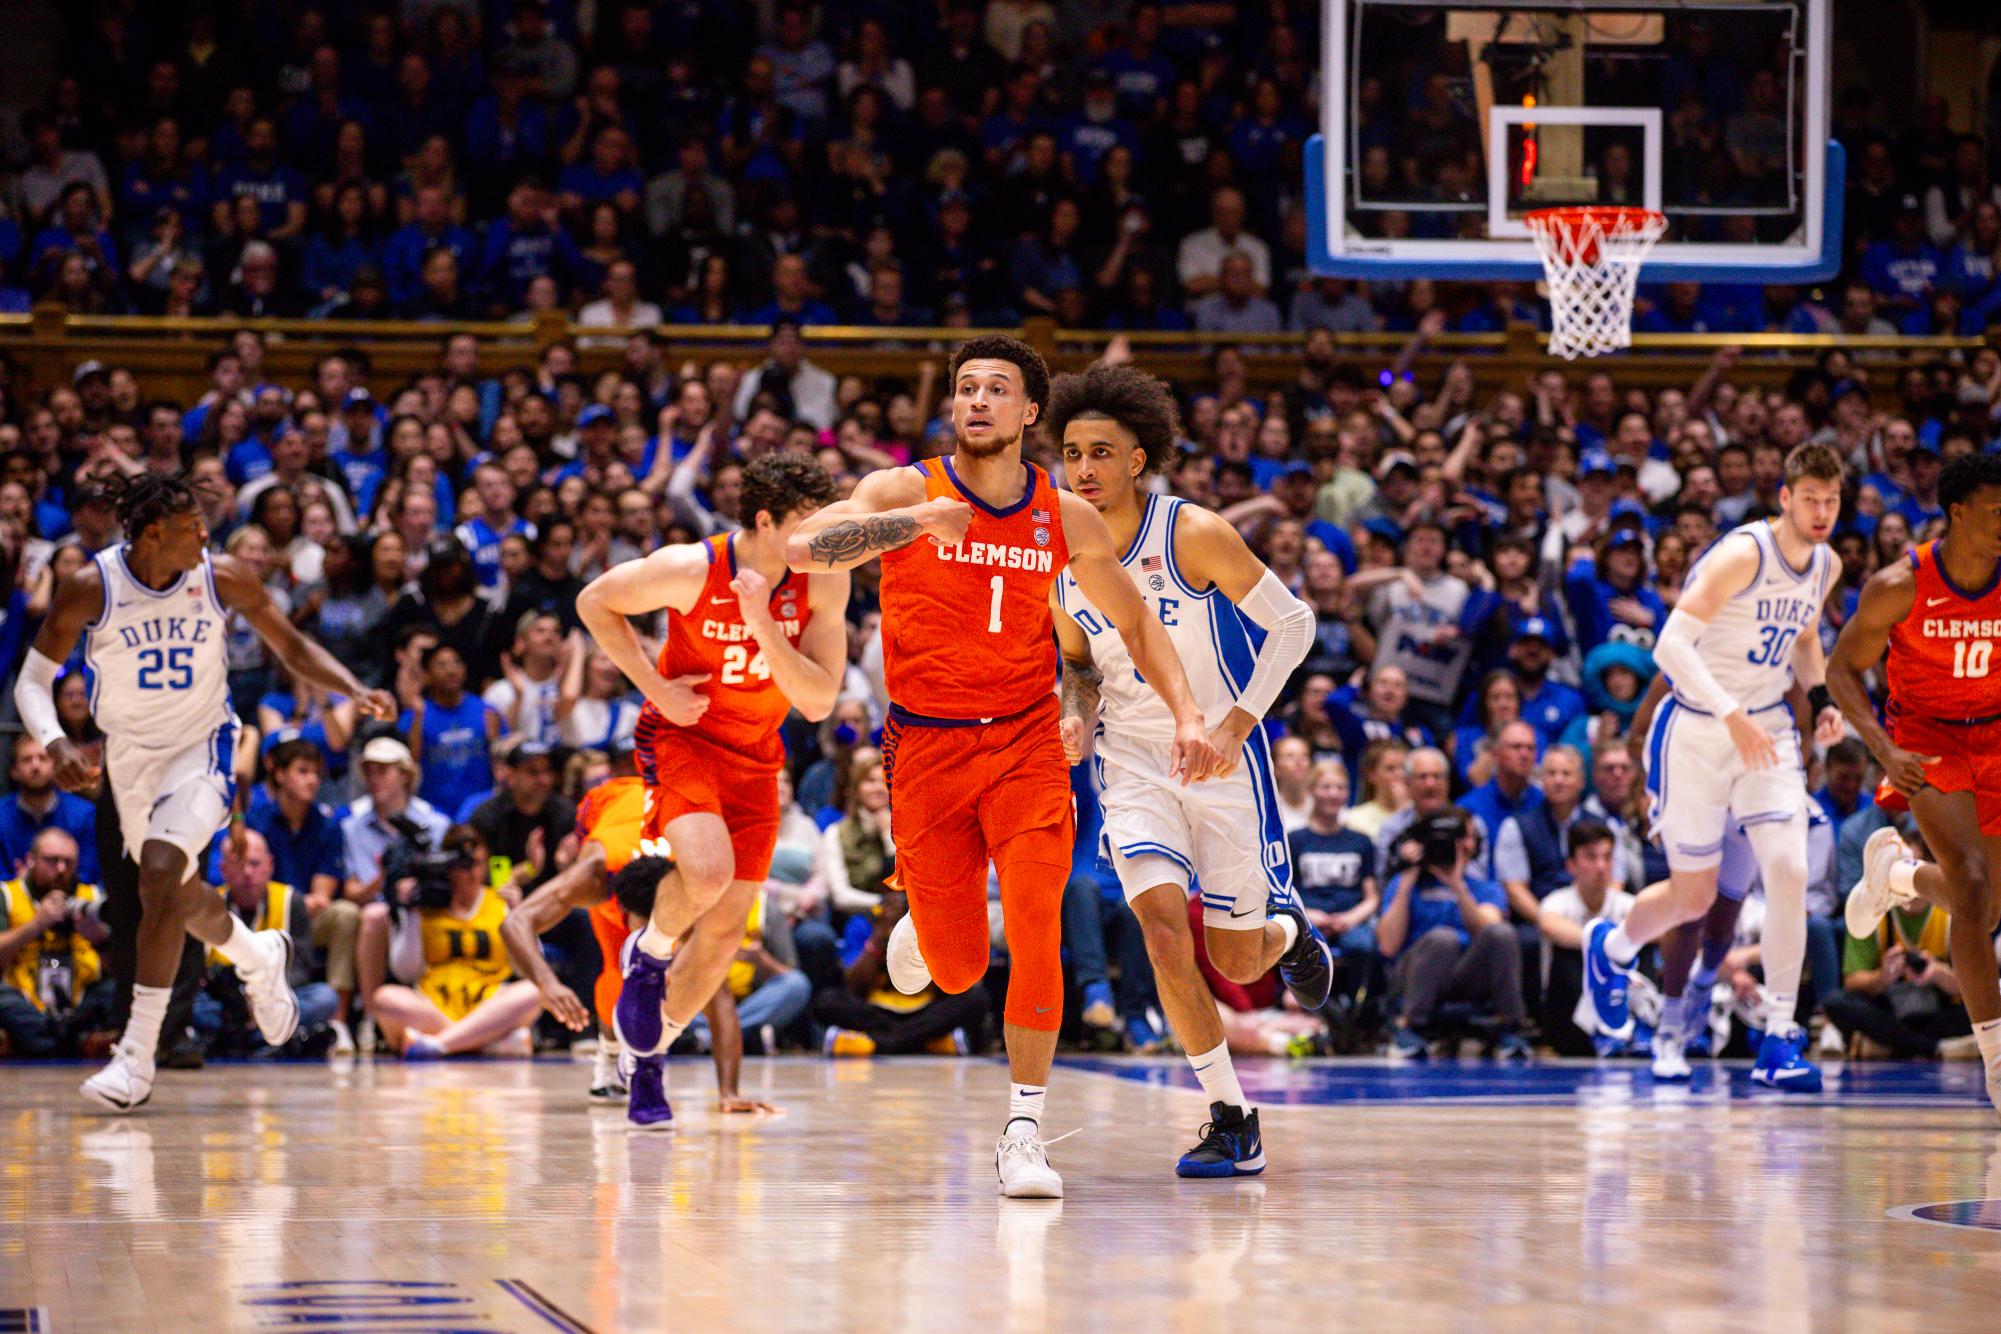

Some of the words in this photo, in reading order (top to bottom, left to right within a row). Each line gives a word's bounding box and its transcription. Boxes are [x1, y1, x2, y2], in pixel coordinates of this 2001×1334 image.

[937, 541, 1054, 573] CLEMSON
[987, 575, 1004, 633] 1
[1073, 597, 1180, 636] DE
[1756, 598, 1815, 628] DUKE
[119, 617, 212, 648] DUKE
[1747, 625, 1797, 668] 30
[138, 648, 194, 690] 25
[721, 645, 771, 684] 24
[1953, 640, 1993, 678] 10
